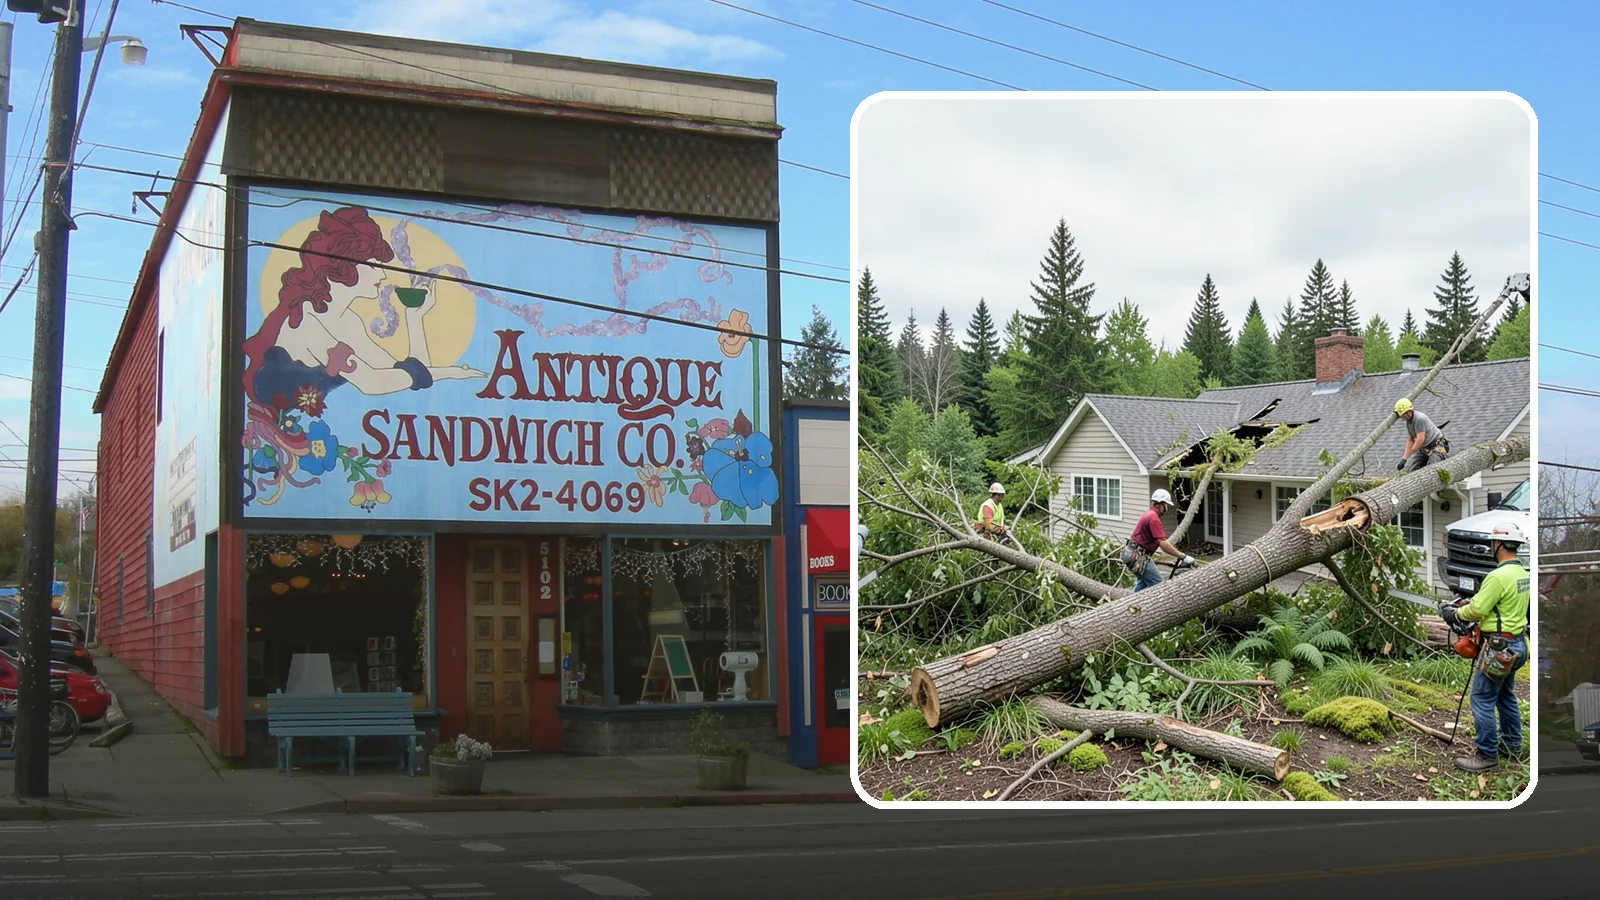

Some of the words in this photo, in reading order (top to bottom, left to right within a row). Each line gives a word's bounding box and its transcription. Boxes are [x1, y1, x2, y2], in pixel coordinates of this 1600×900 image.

[476, 329, 723, 421] ANTIQUE
[361, 409, 604, 467] SANDWICH
[617, 422, 685, 468] CO.
[468, 477, 646, 513] SK2-4069
[539, 541, 552, 600] 5102
[809, 555, 835, 569] BOOKS
